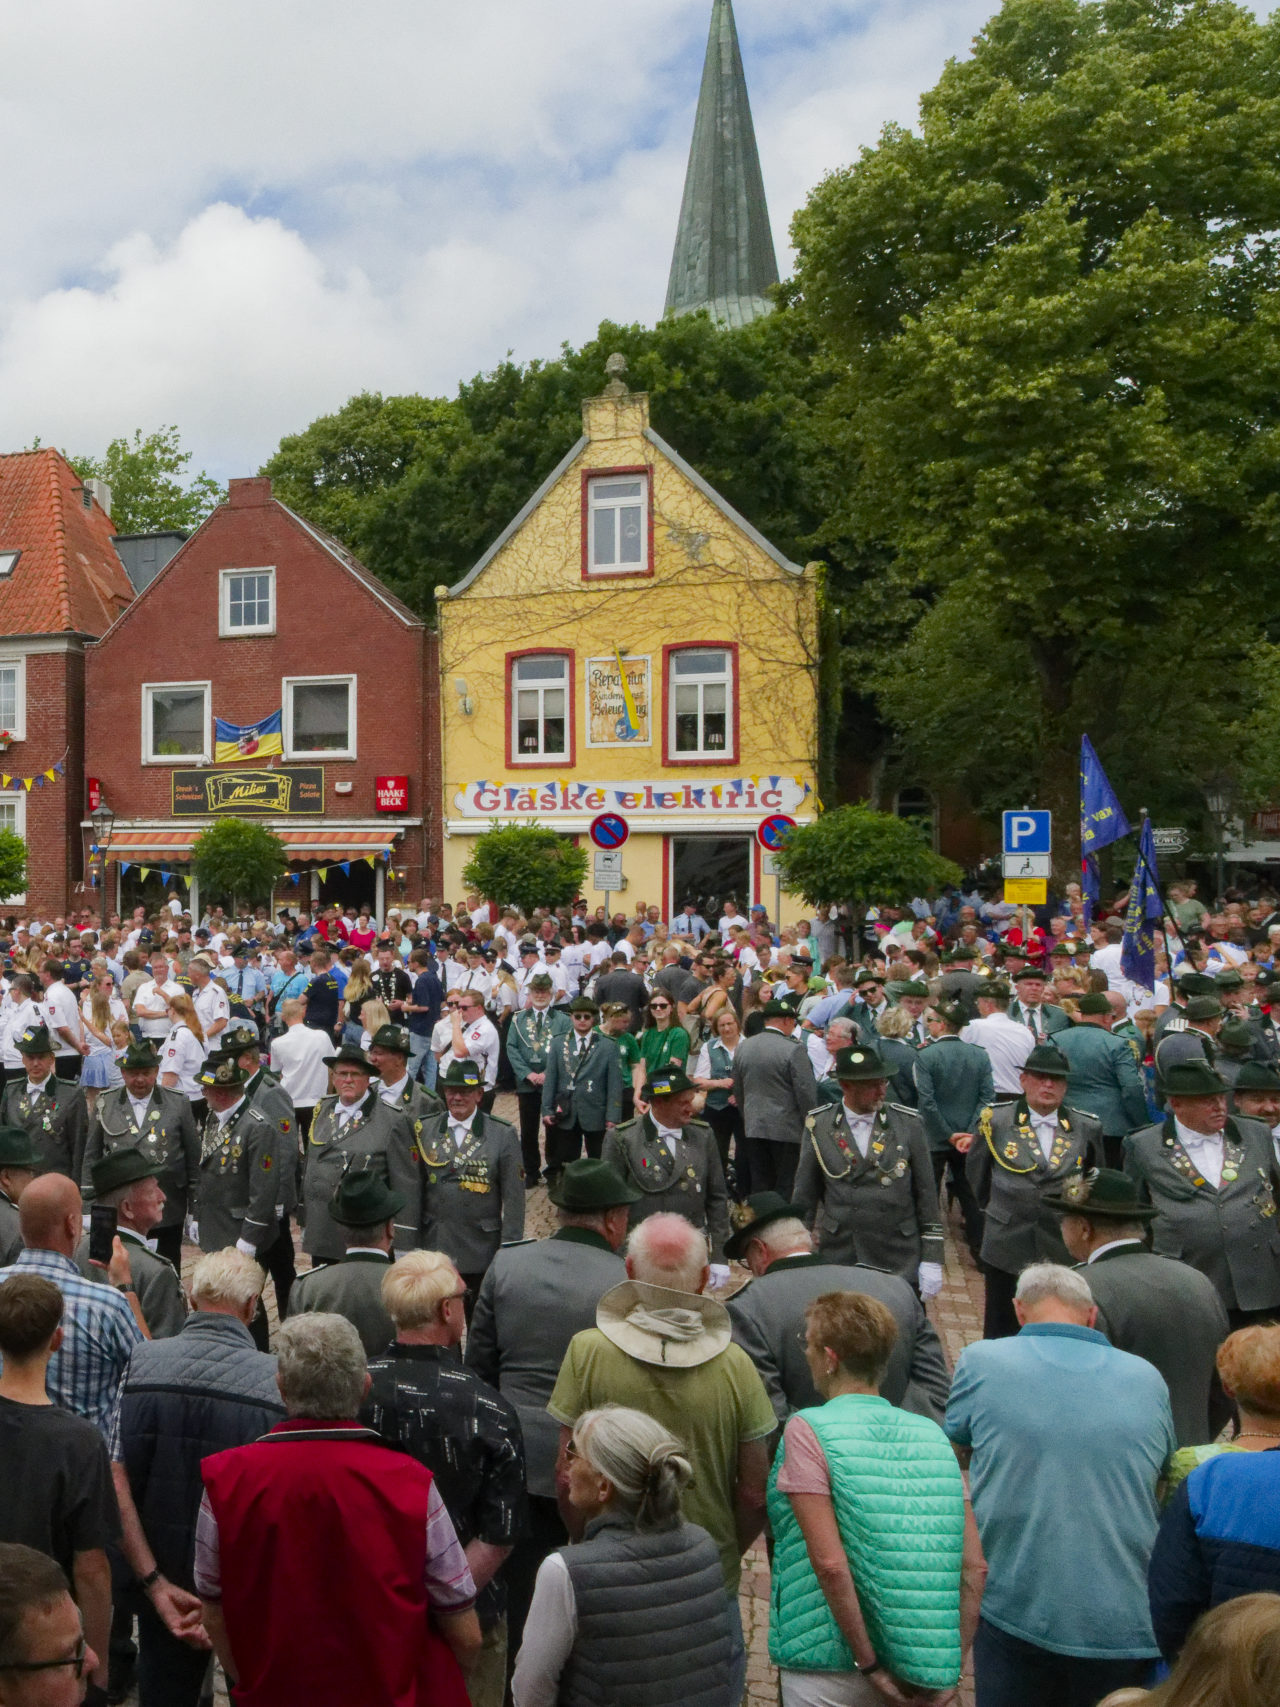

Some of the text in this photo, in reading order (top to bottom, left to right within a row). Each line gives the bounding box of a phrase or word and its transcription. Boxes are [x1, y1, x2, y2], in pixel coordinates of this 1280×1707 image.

[229, 782, 267, 800] Milieu
[377, 788, 406, 798] HAAKE
[472, 783, 784, 812] Gläske elektric
[380, 797, 402, 807] BECK
[1011, 816, 1037, 849] P
